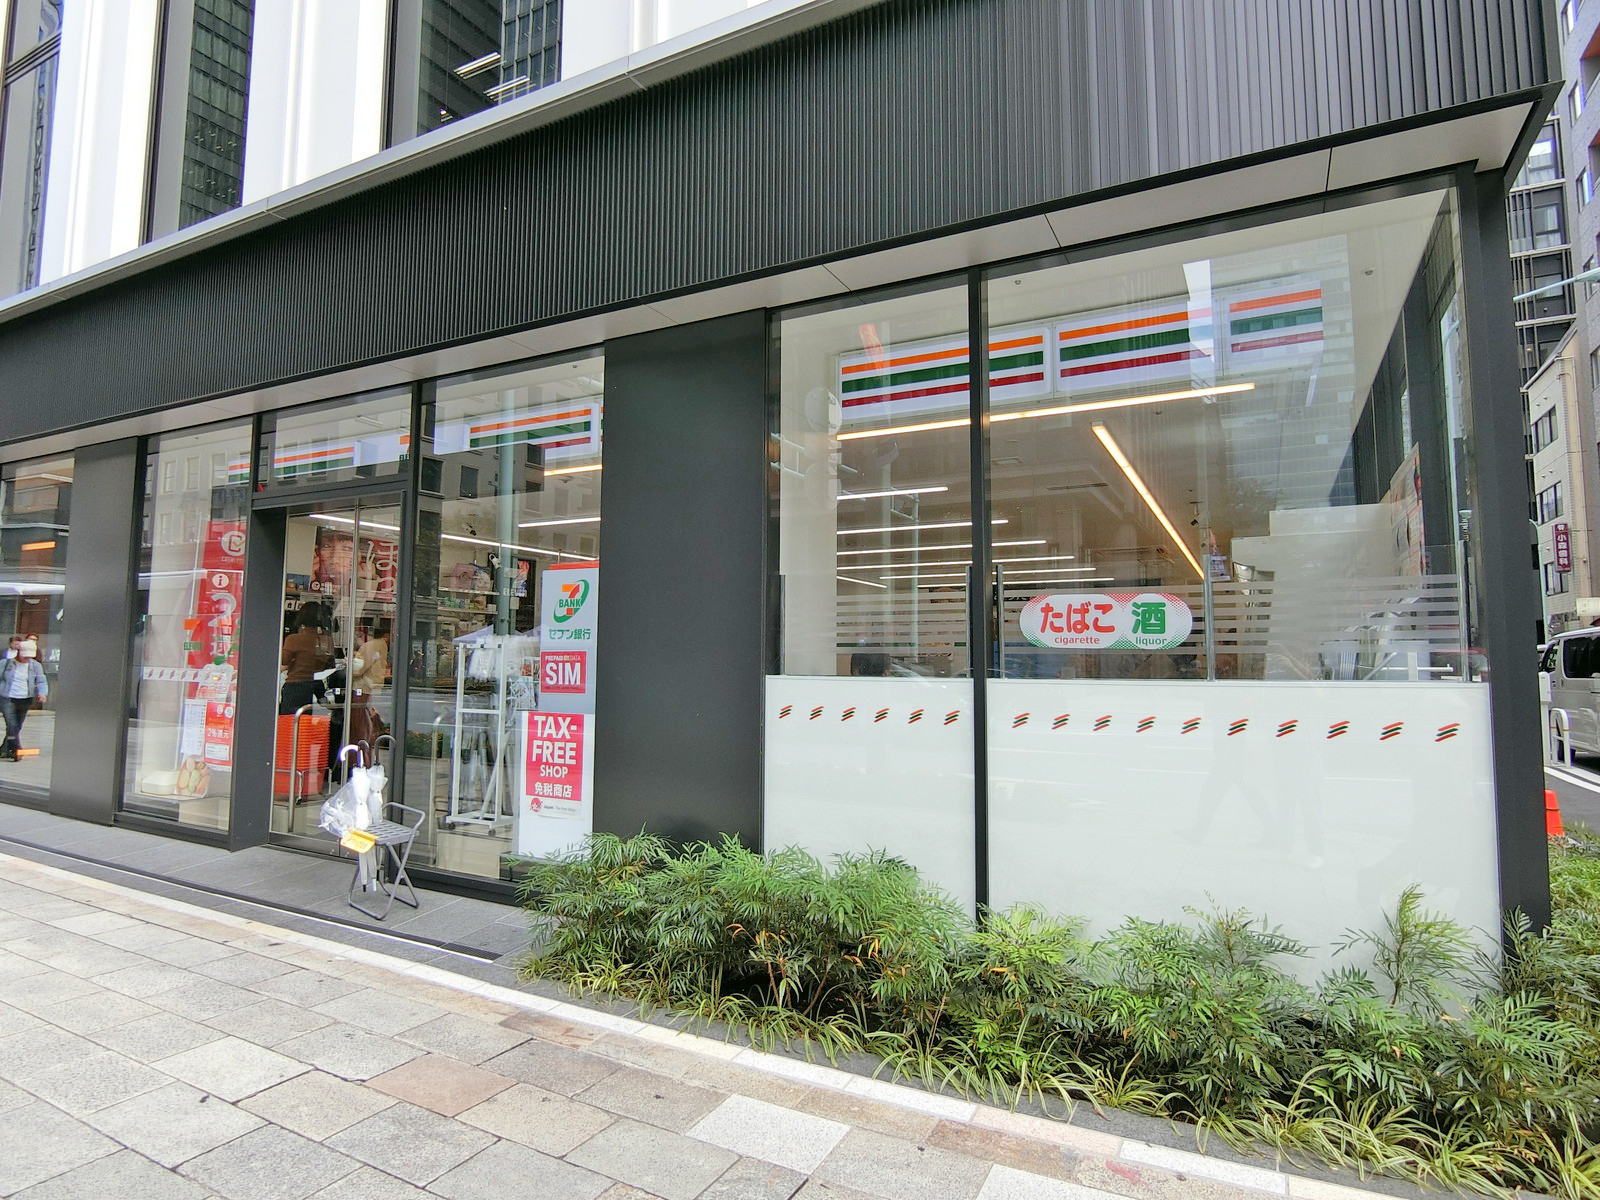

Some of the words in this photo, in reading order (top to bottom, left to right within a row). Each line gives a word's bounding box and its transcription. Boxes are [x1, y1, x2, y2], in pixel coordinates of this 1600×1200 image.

[559, 598, 581, 608] BANK
[1040, 601, 1115, 634] たばこ
[1132, 601, 1167, 635] 酒
[549, 629, 591, 640] セブン銀行
[1054, 636, 1100, 646] cigarette
[1135, 636, 1167, 646] liquor
[545, 662, 581, 685] SIM
[534, 715, 577, 739] TAX-
[532, 740, 577, 764] FREE
[540, 765, 568, 778] SHOP
[534, 781, 572, 798] 免税商店
